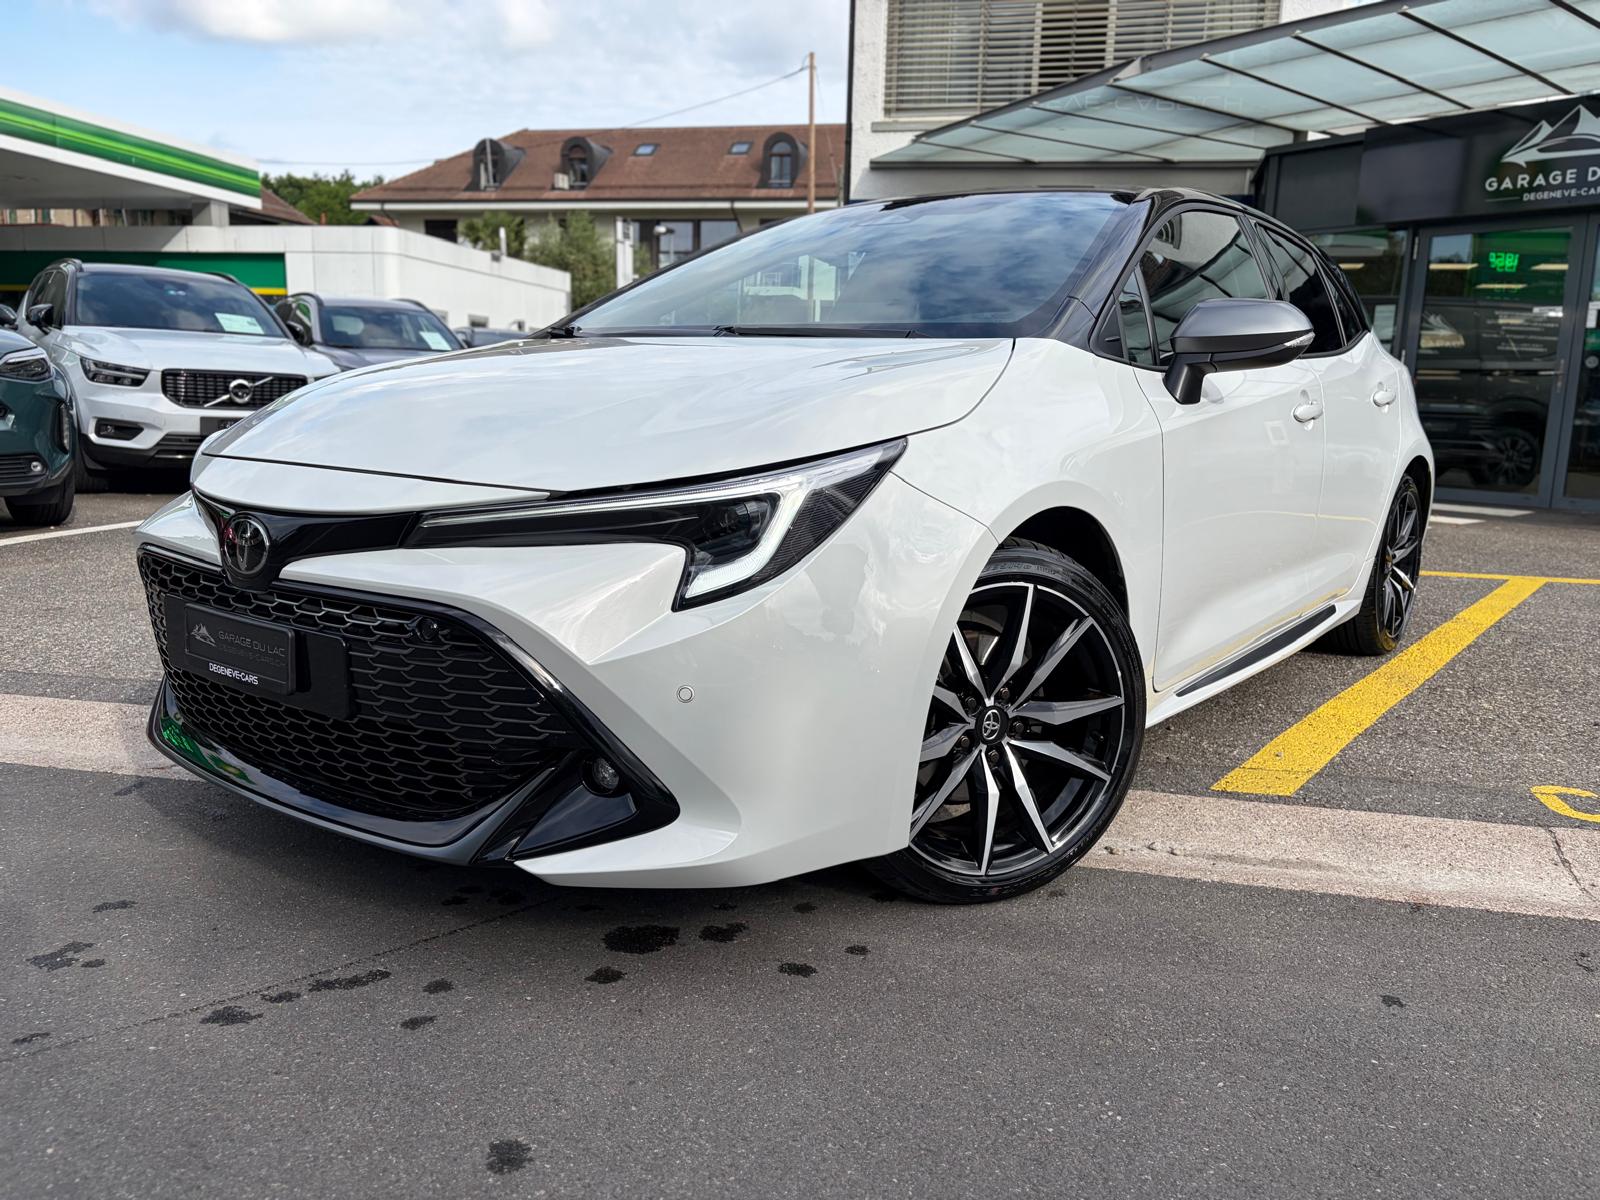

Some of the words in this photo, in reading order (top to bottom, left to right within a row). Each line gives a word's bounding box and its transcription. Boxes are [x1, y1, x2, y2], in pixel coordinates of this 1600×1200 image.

[1485, 169, 1577, 191] GARAGE
[219, 631, 252, 647] GARAGE
[252, 641, 266, 652] DU
[267, 644, 286, 658] LAC
[209, 662, 258, 685] DEGENEVE-CARS
